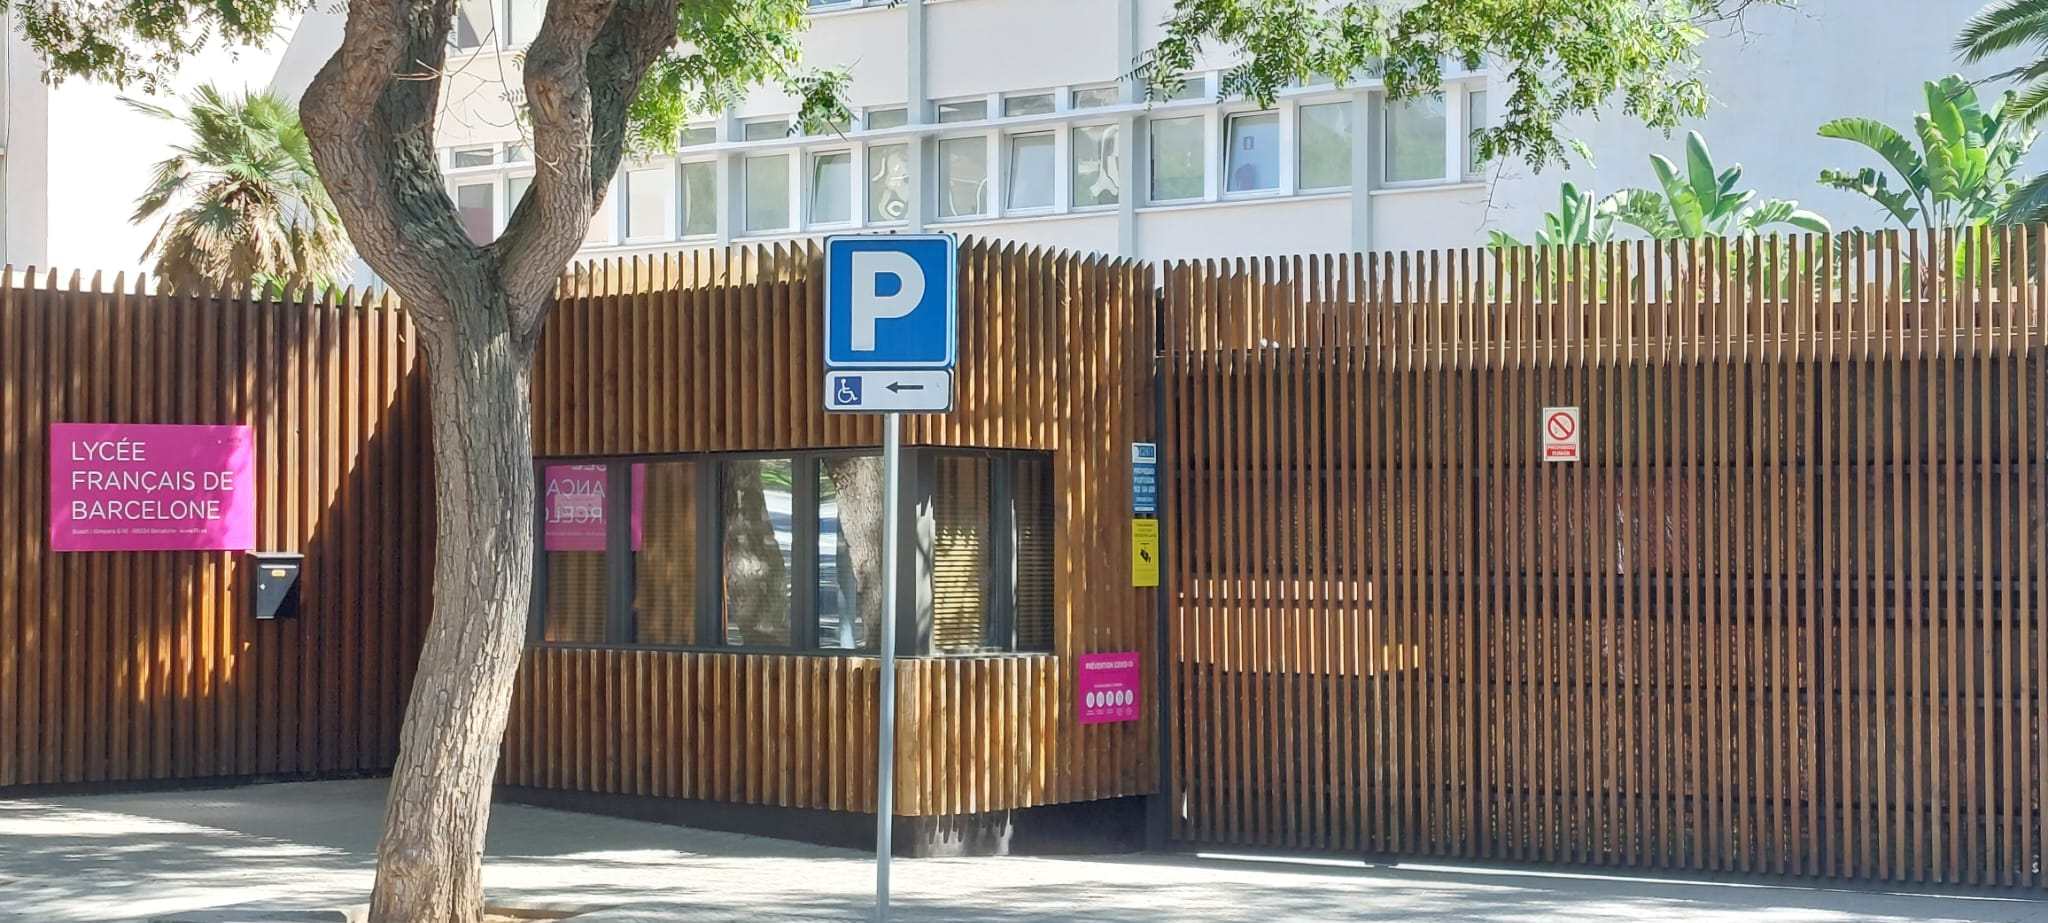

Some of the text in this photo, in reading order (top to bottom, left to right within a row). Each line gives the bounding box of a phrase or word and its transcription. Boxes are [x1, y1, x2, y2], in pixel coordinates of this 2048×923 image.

[851, 251, 926, 351] P
[71, 437, 146, 461] LYCÉE
[71, 471, 234, 494] FRANÇAIS DE
[71, 500, 221, 520] BARCELONE
